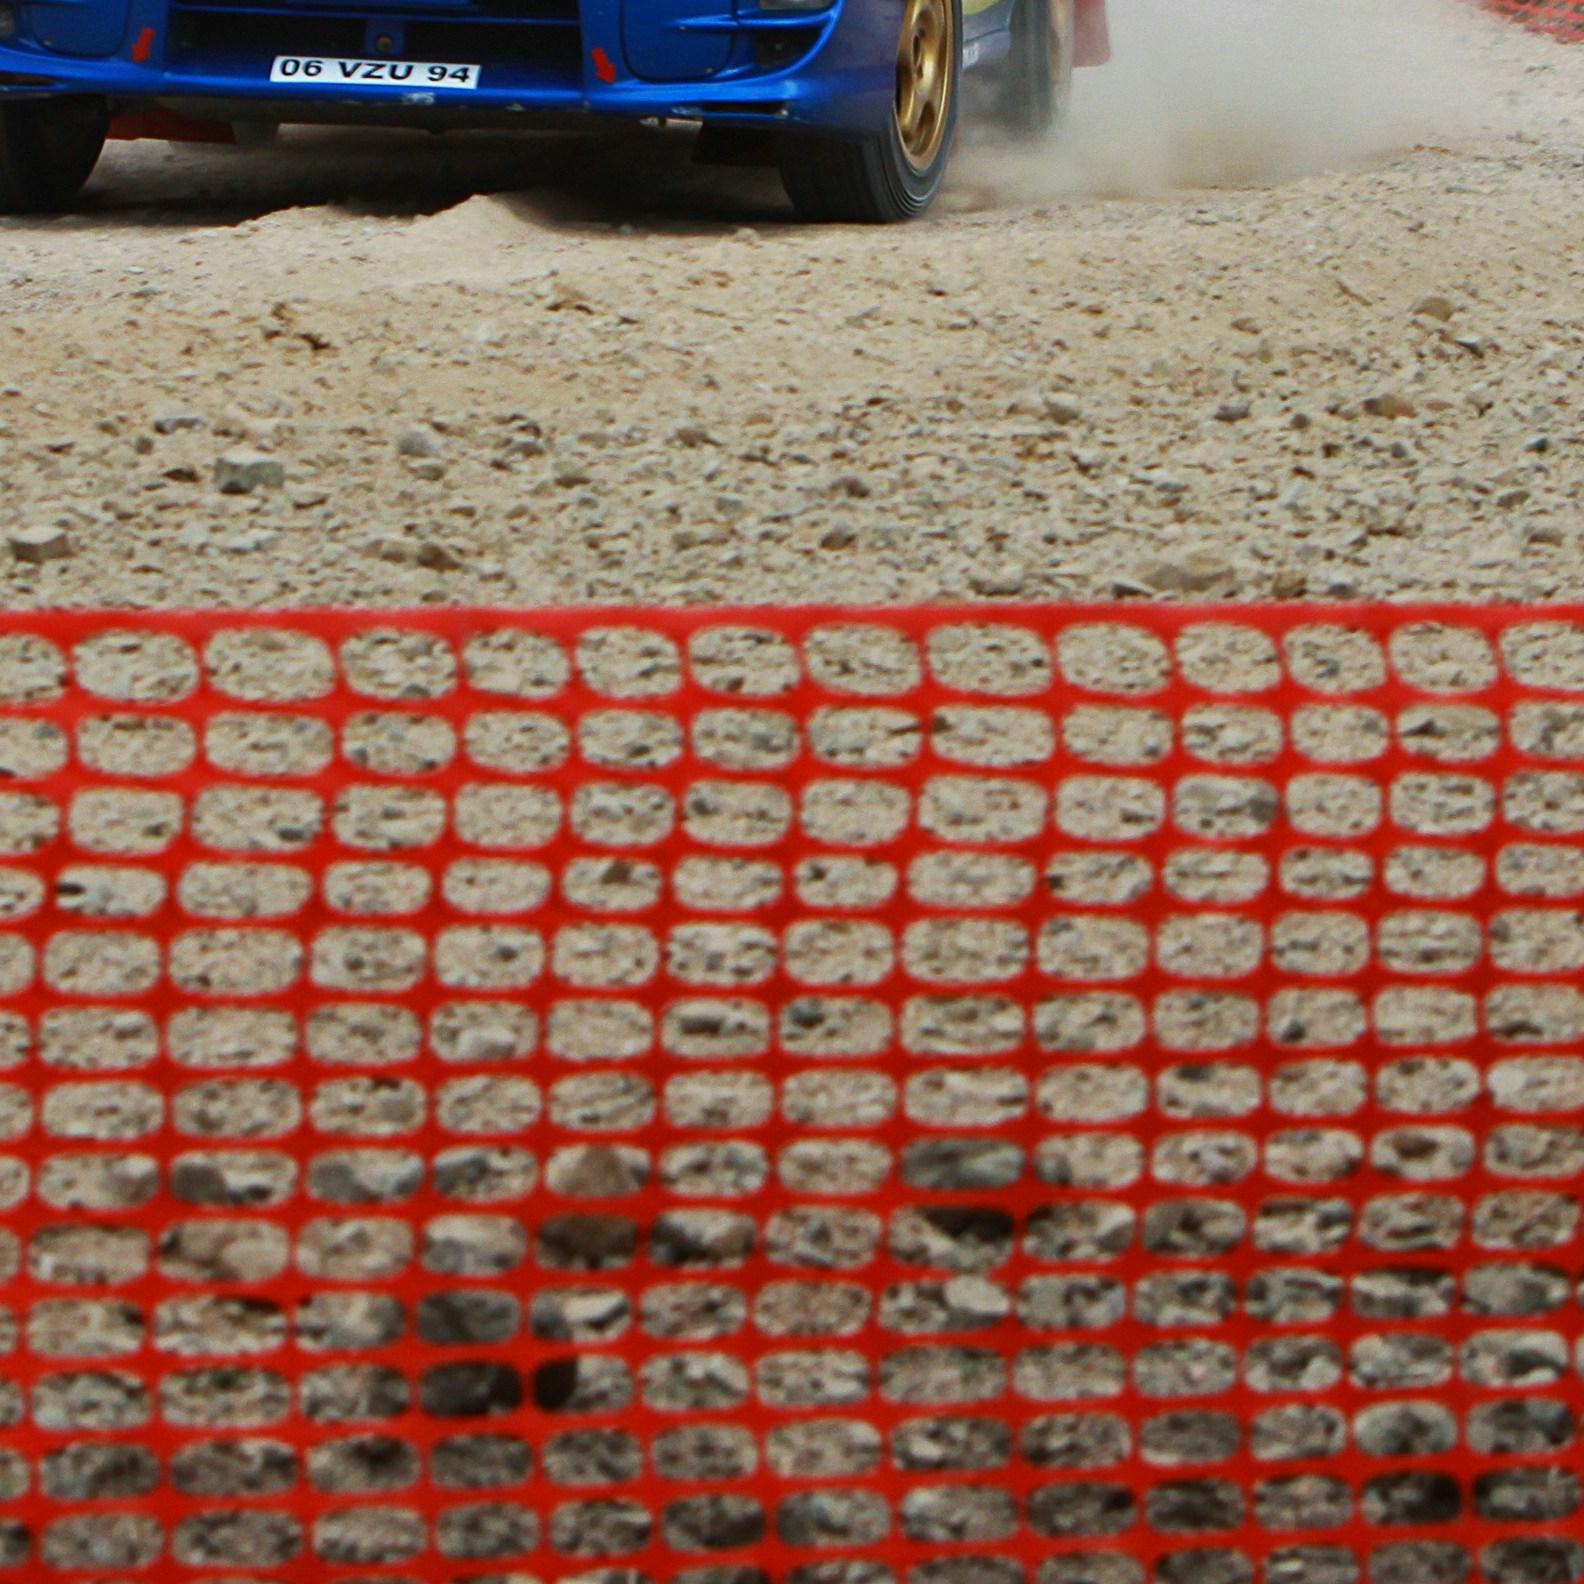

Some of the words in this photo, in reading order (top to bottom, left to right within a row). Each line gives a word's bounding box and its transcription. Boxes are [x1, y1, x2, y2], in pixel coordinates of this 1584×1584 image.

[280, 59, 324, 77] 06
[339, 61, 414, 80] VZU
[427, 64, 471, 83] 94
